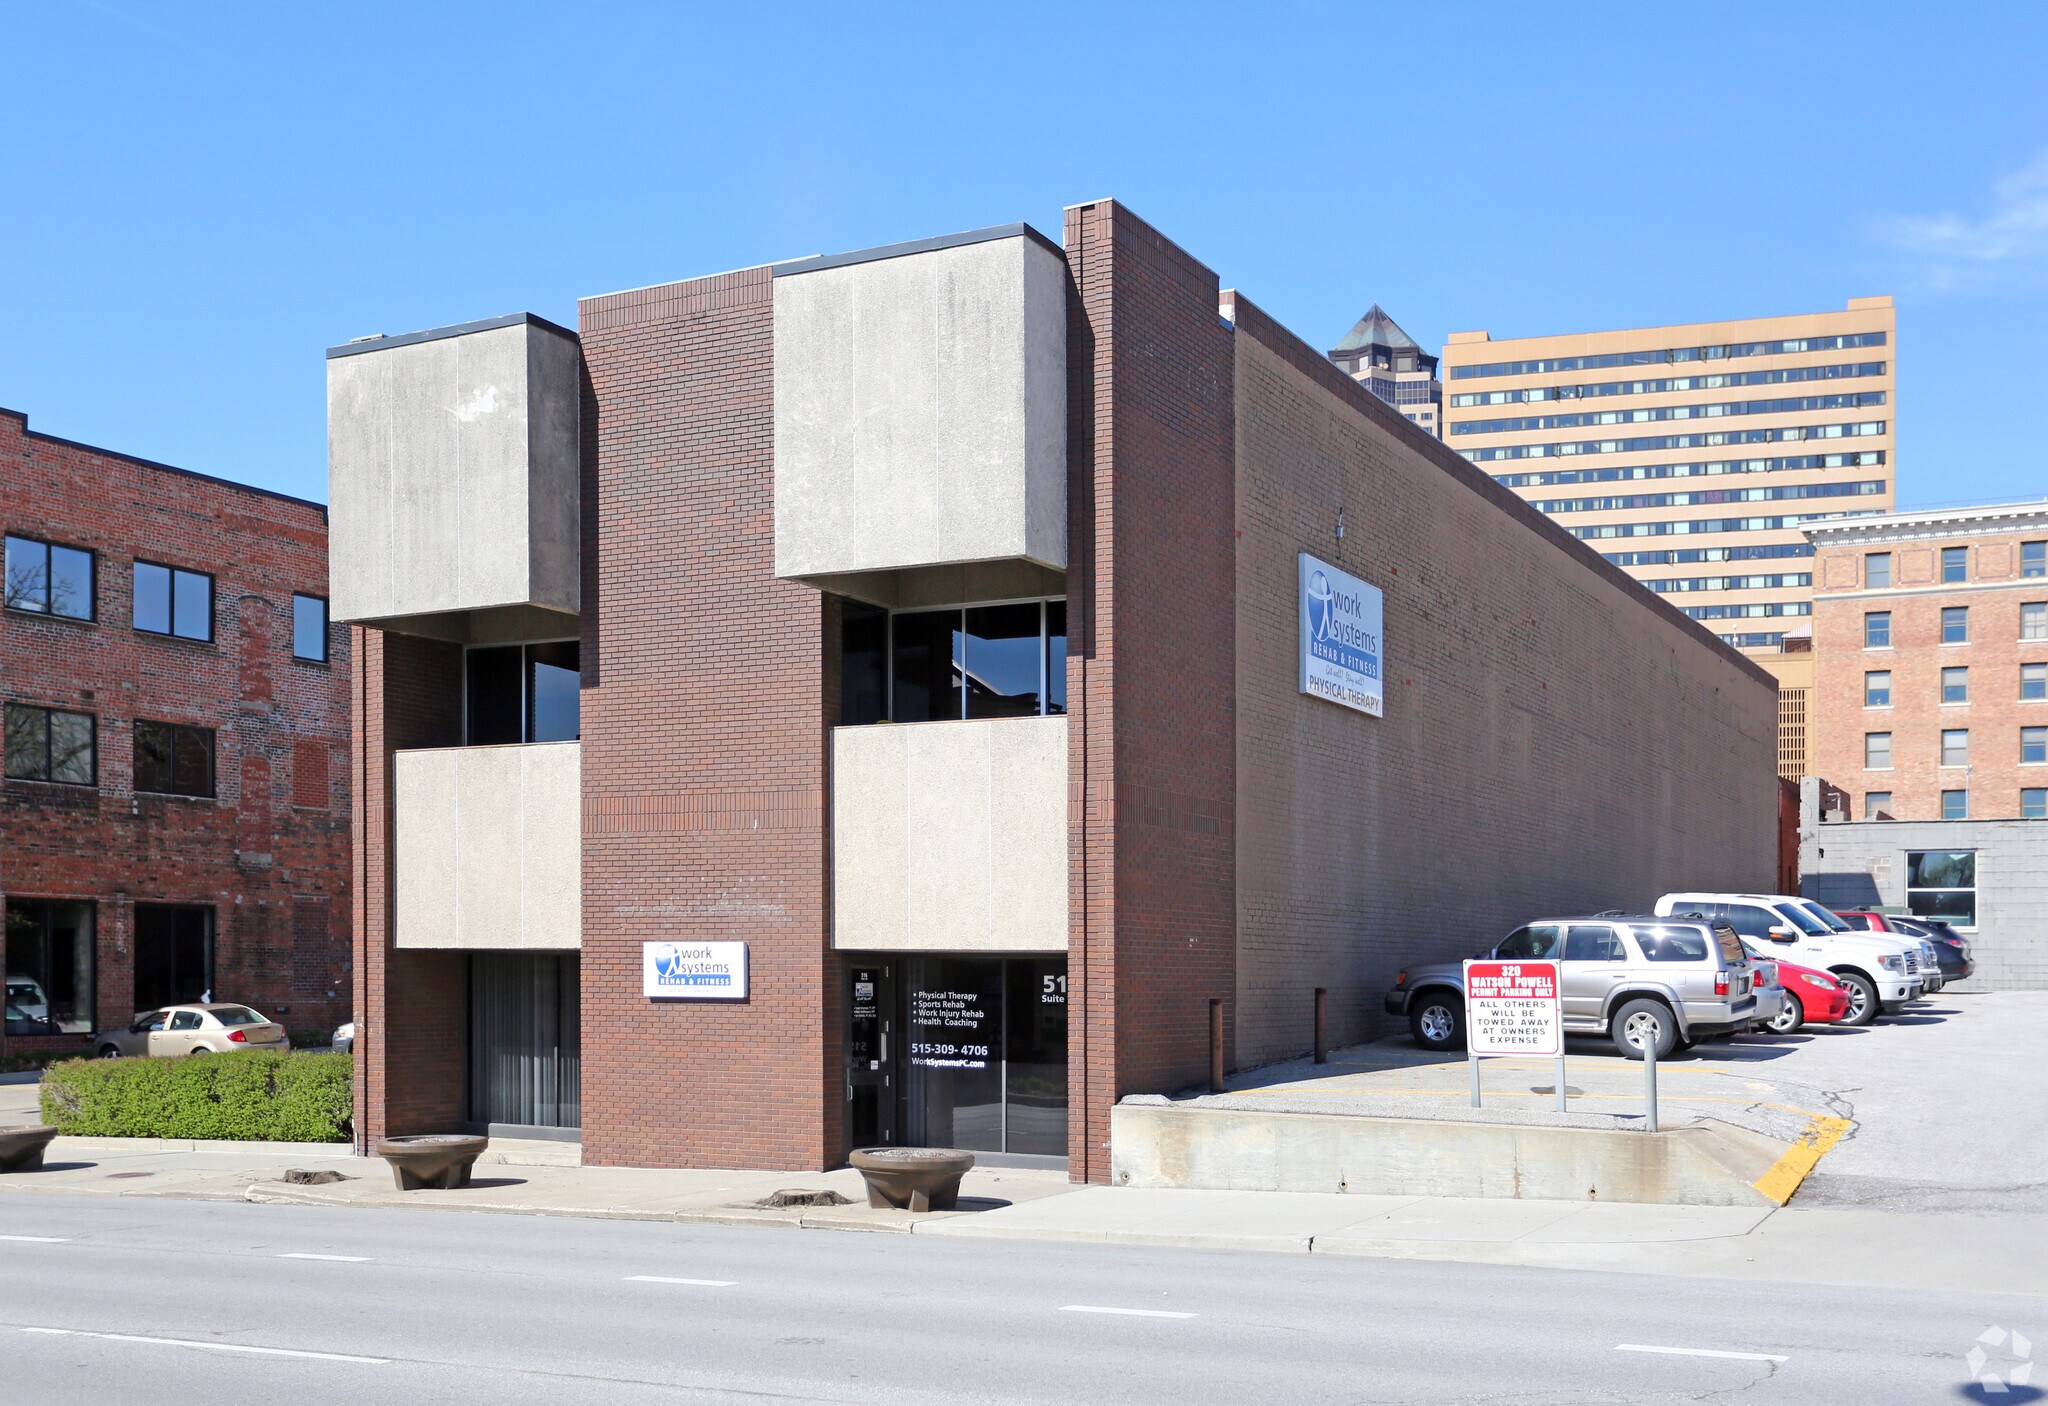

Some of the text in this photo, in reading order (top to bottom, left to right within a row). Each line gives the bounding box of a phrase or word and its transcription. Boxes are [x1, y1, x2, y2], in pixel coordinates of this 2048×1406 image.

[1333, 590, 1361, 619] work
[1333, 619, 1376, 653] systems
[1313, 641, 1376, 677] REHAB & FITNESS
[1309, 675, 1380, 711] PHYSICAL THERAPY
[681, 946, 712, 959] work
[681, 962, 729, 977] systems
[1501, 965, 1521, 977] 320
[1471, 976, 1553, 988] WATSON POWELL
[918, 991, 977, 1001] Physical Therapy
[1471, 988, 1553, 997] PERMIT PARKING ONLY
[1041, 994, 1065, 1003] Suite
[918, 1000, 941, 1009] Sports
[918, 1009, 984, 1018] Work Injury Rehab
[918, 1017, 978, 1028] Health Coaching
[1501, 1027, 1546, 1035] OWNERS
[1489, 1036, 1539, 1044] EXPENSE
[911, 1057, 985, 1068] WorkSystemsPC.com
